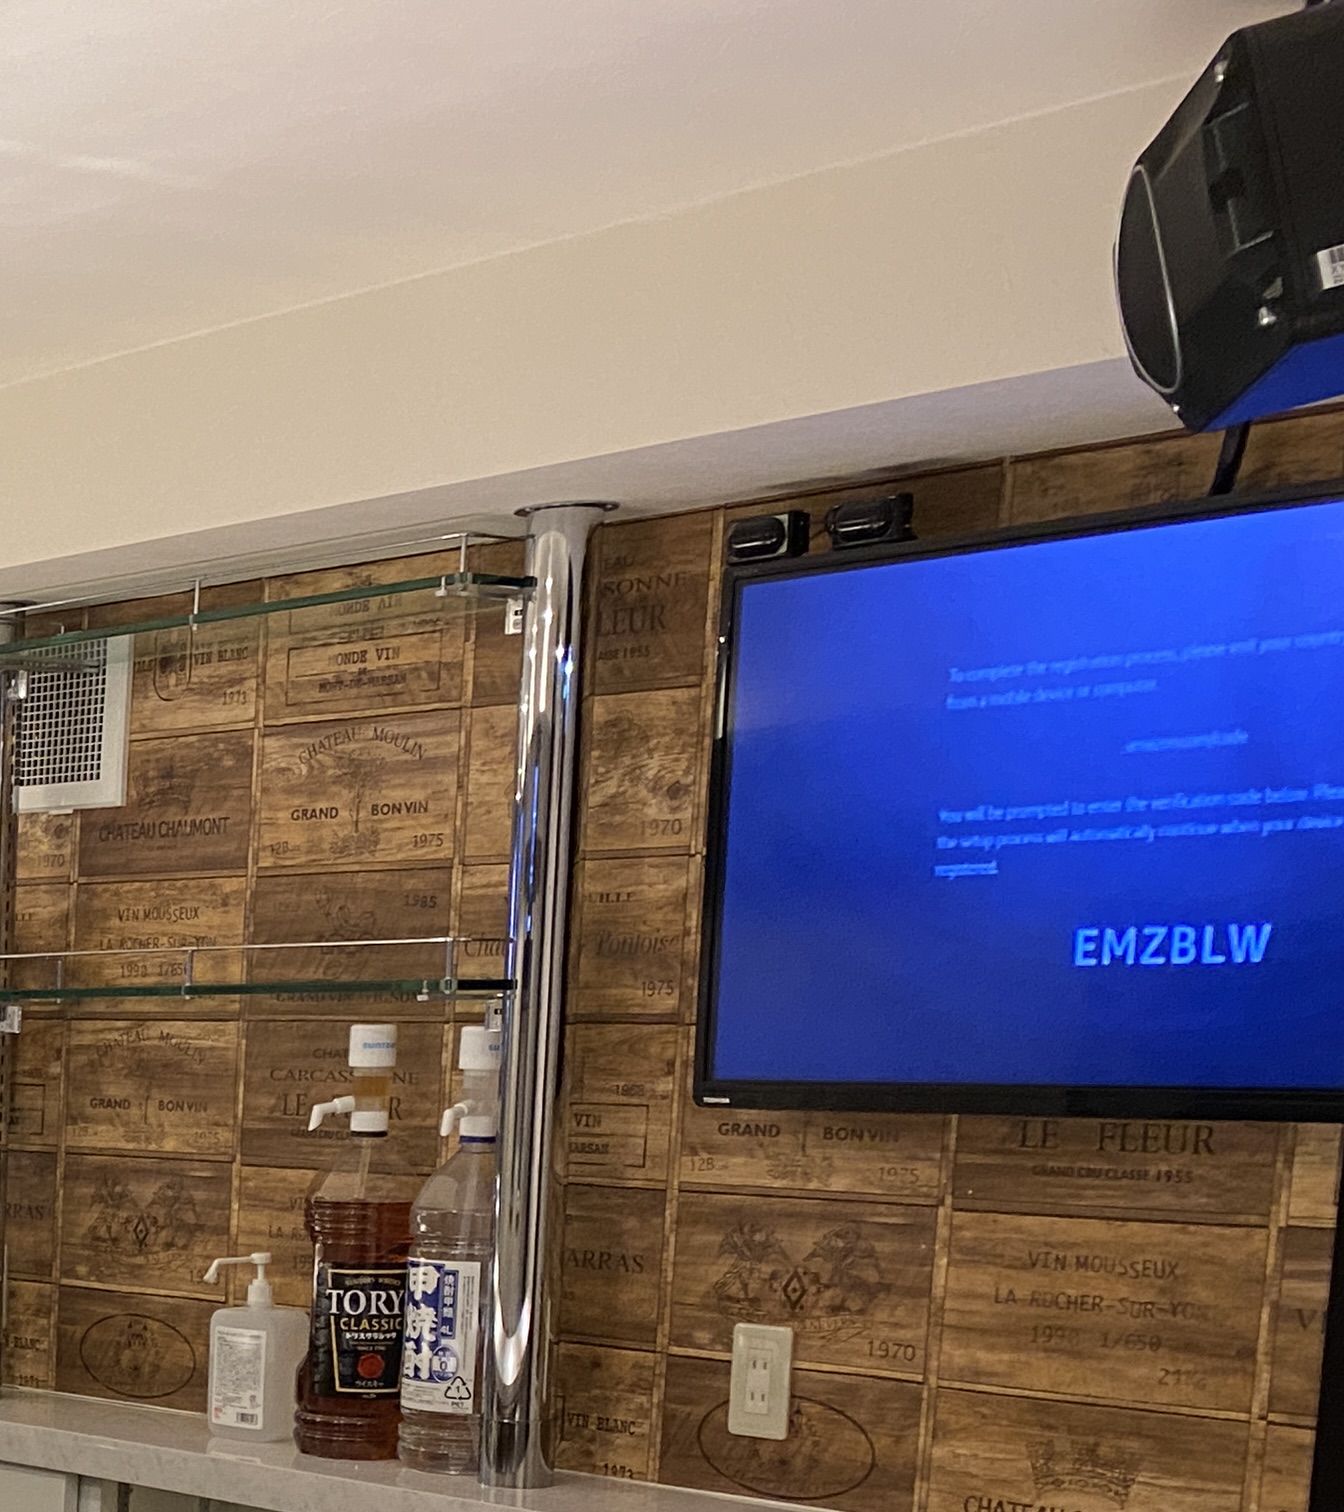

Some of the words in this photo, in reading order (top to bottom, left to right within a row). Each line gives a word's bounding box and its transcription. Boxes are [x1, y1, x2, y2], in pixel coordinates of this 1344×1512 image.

[290, 806, 339, 821] GRAND
[1073, 922, 1273, 966] EMZBLW
[717, 1122, 781, 1138] GRAND
[1097, 1122, 1216, 1156] FLEUR
[1028, 1252, 1067, 1271] VIN
[1075, 1255, 1180, 1281] MOUSSEUX
[866, 1338, 917, 1362] 1970
